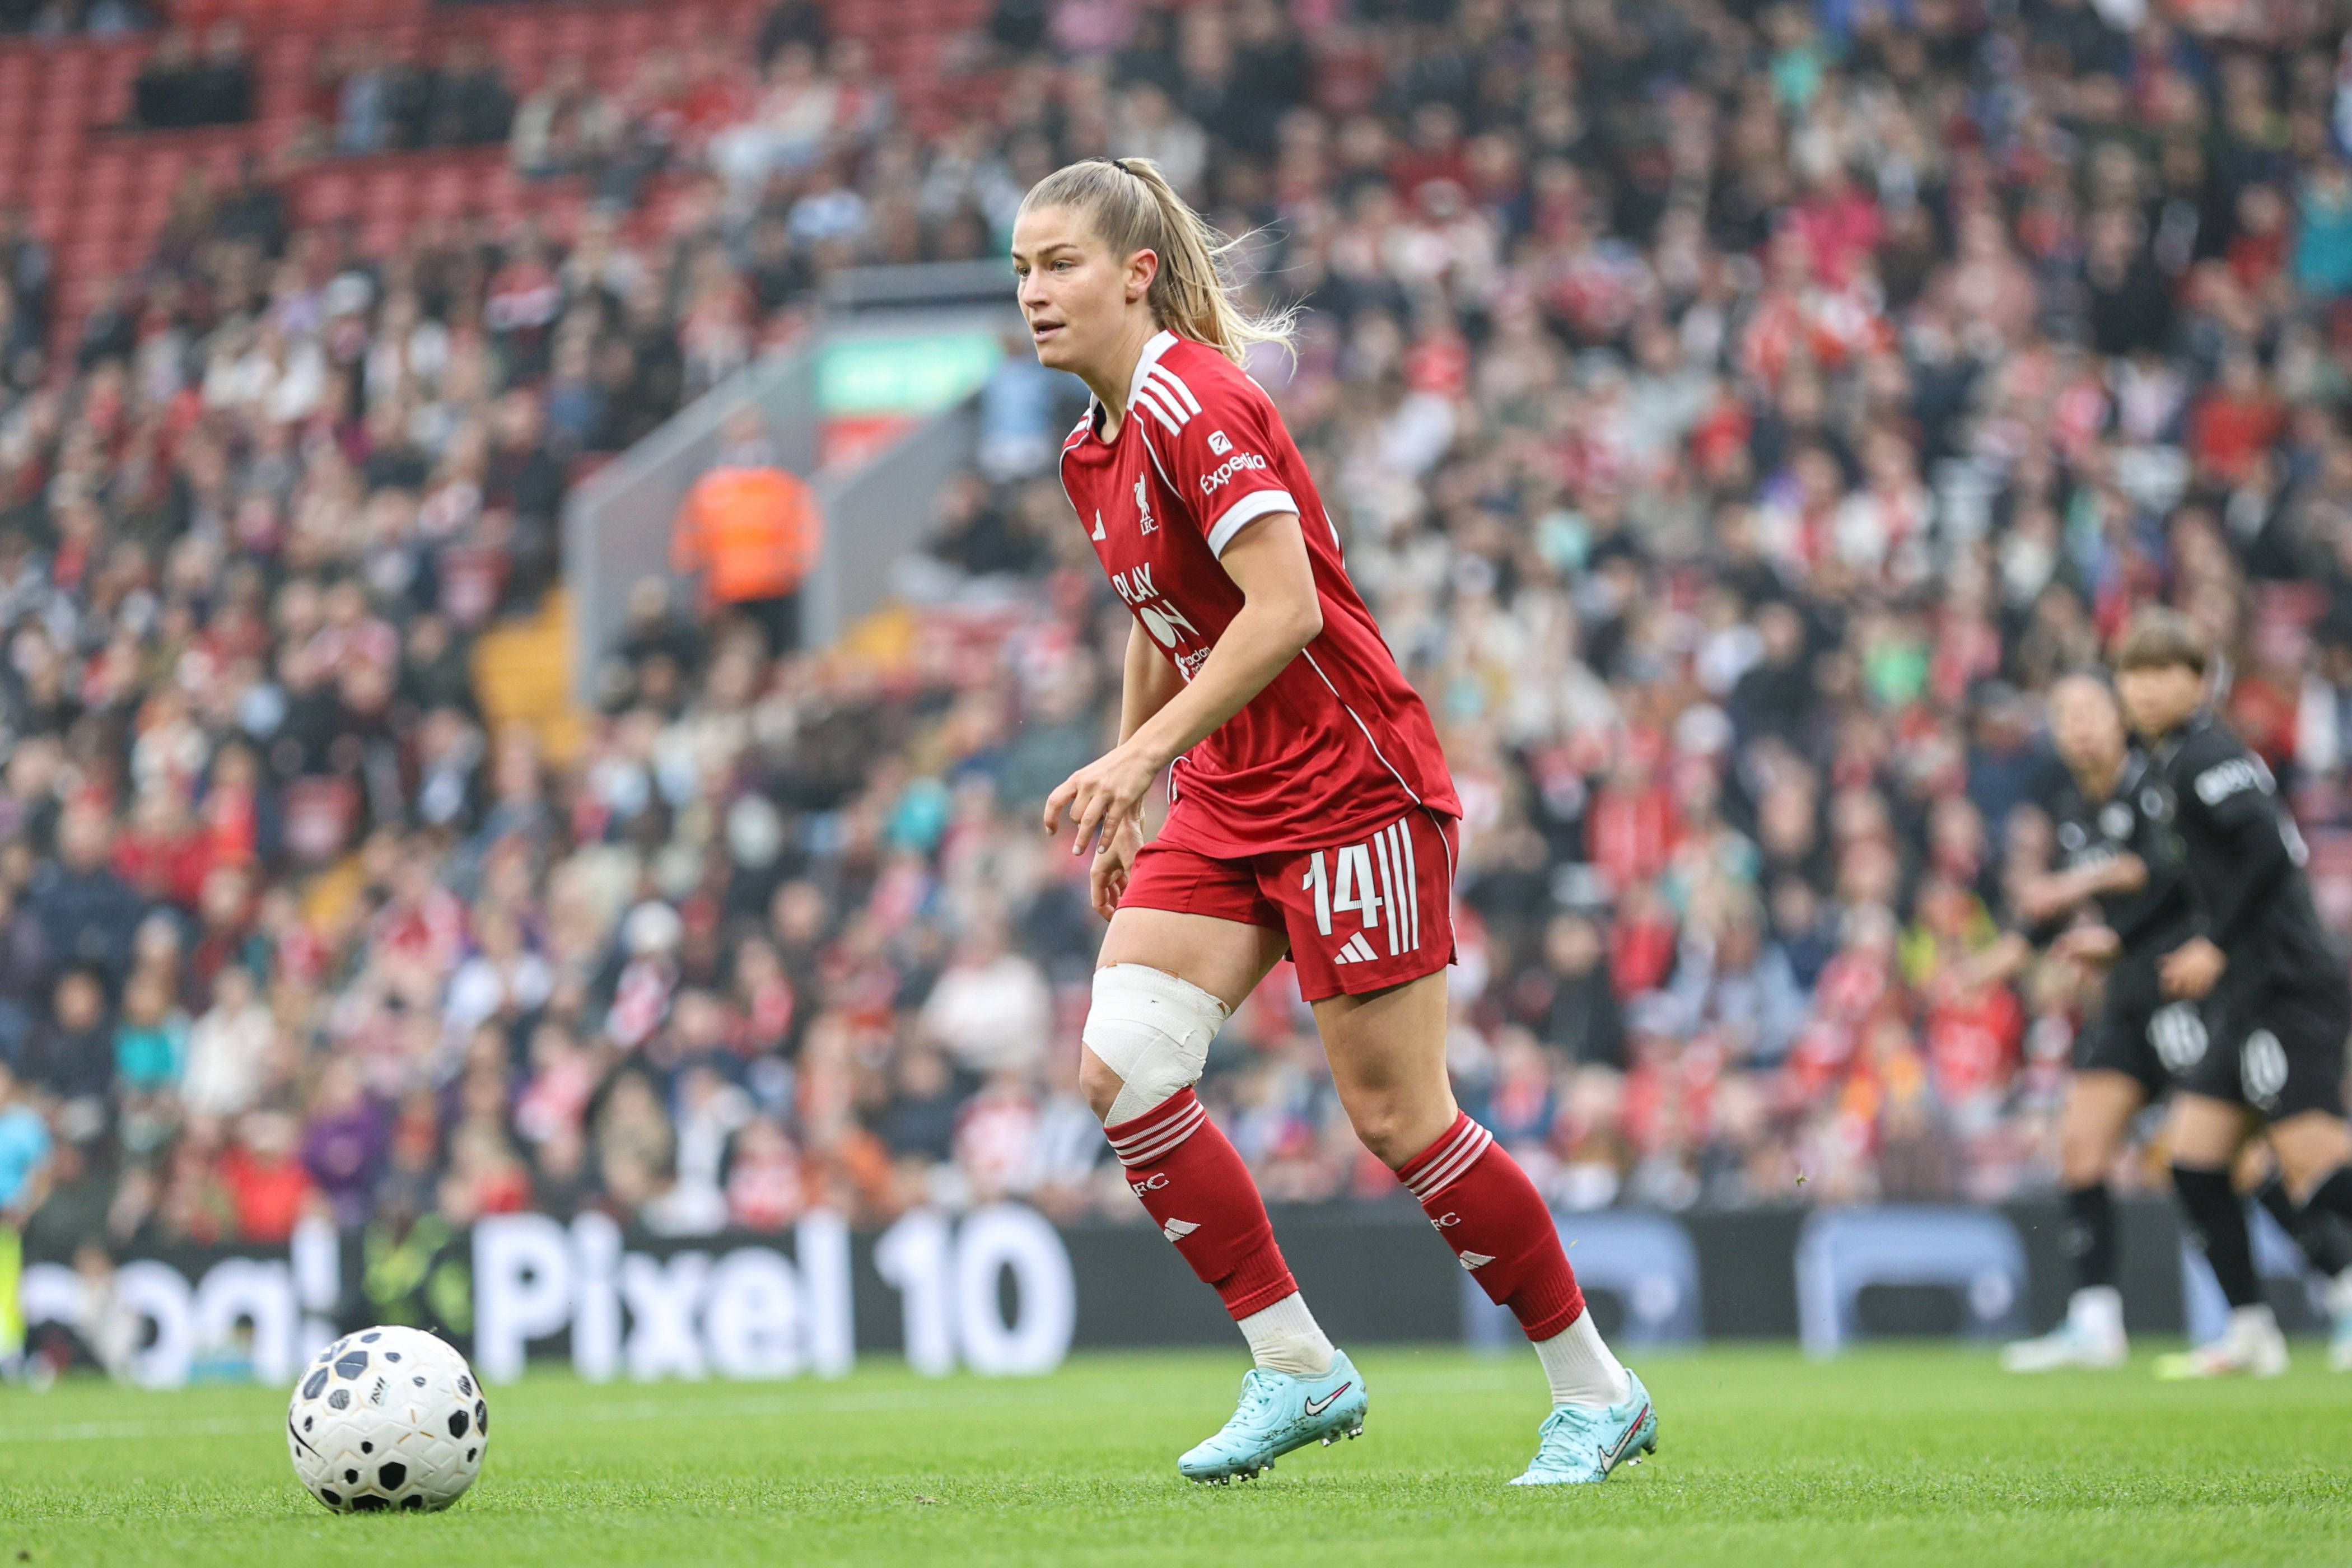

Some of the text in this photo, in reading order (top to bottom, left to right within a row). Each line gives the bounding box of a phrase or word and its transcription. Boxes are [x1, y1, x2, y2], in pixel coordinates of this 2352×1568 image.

[1200, 452, 1267, 496] Expedia
[1112, 562, 1160, 605] PLAY
[1140, 599, 1200, 648] ON
[1302, 843, 1383, 936] 14
[1132, 1173, 1170, 1197] FC
[1430, 1212, 1461, 1231] FC
[472, 1207, 856, 1384] Pixel
[875, 1203, 1076, 1379] 10
